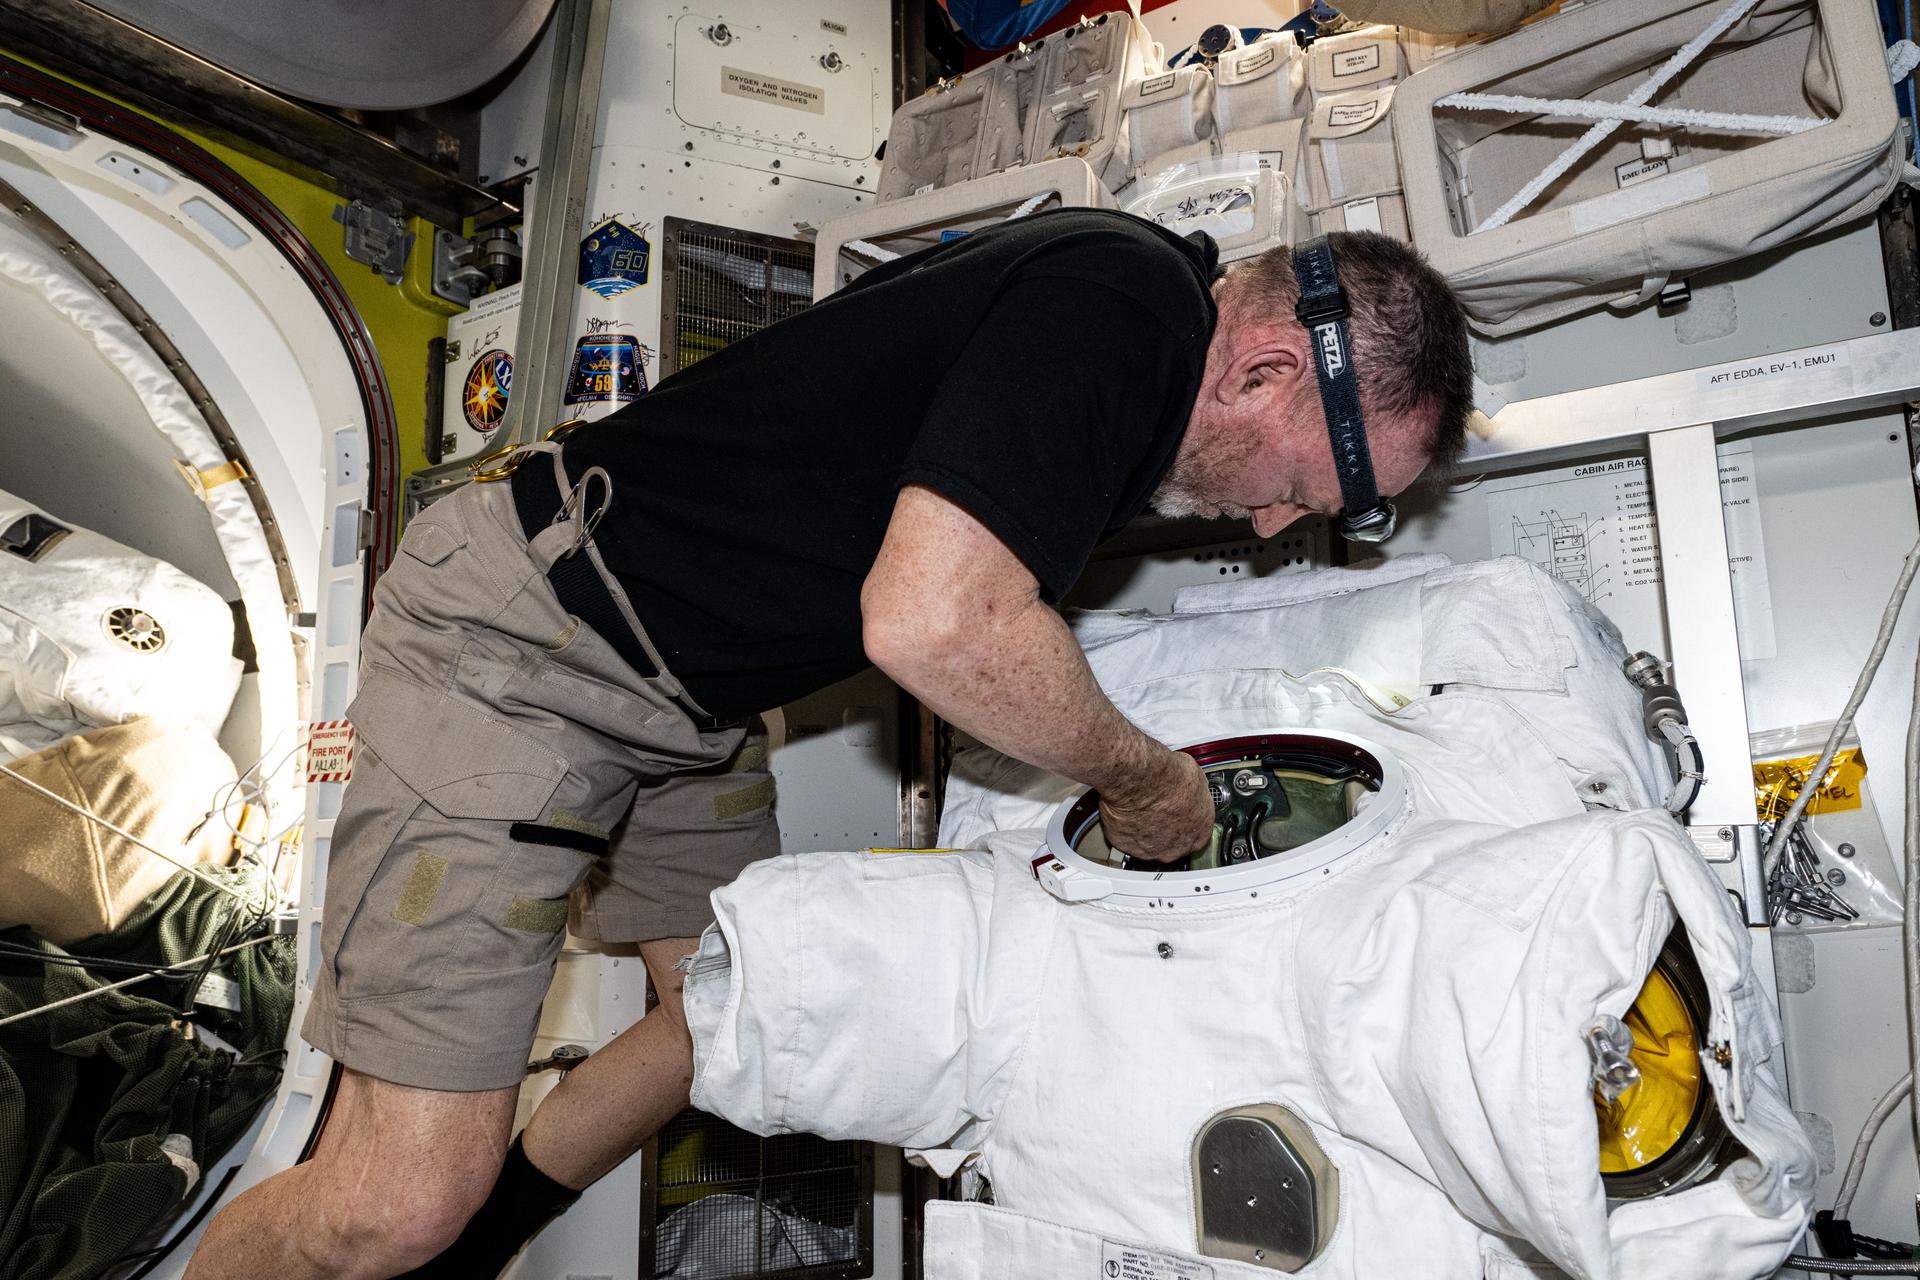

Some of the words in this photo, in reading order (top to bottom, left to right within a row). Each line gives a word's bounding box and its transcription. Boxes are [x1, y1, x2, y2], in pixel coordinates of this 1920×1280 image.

[728, 74, 759, 87] OXYGEN
[762, 82, 778, 91] AND
[781, 87, 818, 100] NITROGEN
[739, 84, 777, 98] ISOLATION
[781, 94, 808, 105] VALVES
[1622, 170, 1640, 181] EMU
[1641, 160, 1664, 174] GLOV
[611, 249, 648, 273] 60
[1308, 249, 1324, 286] TIKKA
[633, 345, 642, 365] HAGUE
[1314, 321, 1344, 380] PETZL
[1710, 373, 1730, 384] AFT
[1734, 368, 1768, 380] EDDA,
[1770, 361, 1801, 374] EV-1,
[1804, 354, 1836, 368] EMU1
[594, 374, 612, 392] 59
[638, 372, 647, 390] KOCH
[1340, 419, 1360, 476] TIKKA
[1574, 465, 1606, 477] CABIN
[1608, 462, 1625, 471] AIR
[1627, 458, 1649, 468] RAC
[1624, 480, 1644, 488] METAL
[1720, 466, 1740, 474] PARE)
[1625, 490, 1652, 499] ELECTR
[1731, 476, 1749, 484] SIDE)
[1730, 498, 1750, 506] VALVE
[1628, 524, 1644, 532] HEAT
[1630, 534, 1648, 542] INLET
[1632, 556, 1652, 564] CABIN
[312, 732, 339, 740] EMERGENCY
[312, 747, 327, 757] FIRE
[328, 746, 346, 756] PORT
[1122, 1272, 1140, 1280] CODE
[1123, 1264, 1142, 1274] SERIAL
